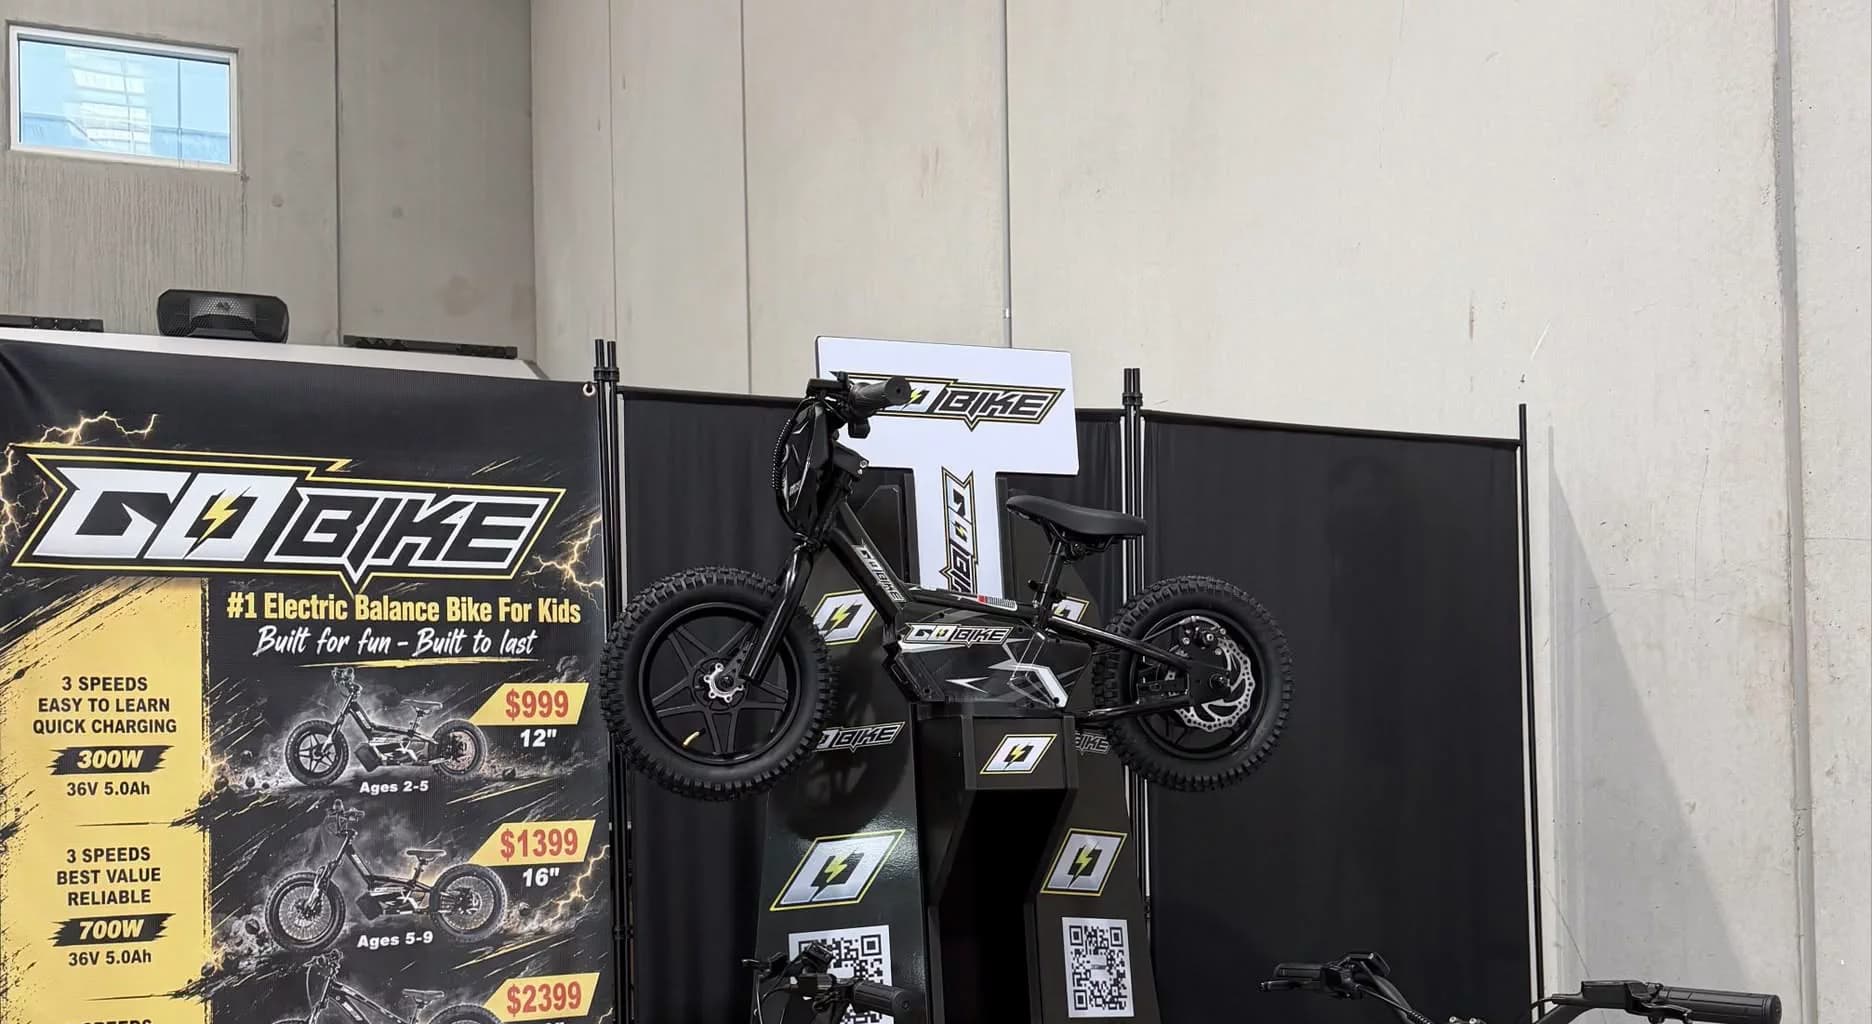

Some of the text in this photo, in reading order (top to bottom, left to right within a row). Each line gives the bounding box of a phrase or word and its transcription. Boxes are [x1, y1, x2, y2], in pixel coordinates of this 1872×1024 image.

[226, 591, 581, 624] #1 Electric Balance Bike For Kids
[252, 625, 311, 657] Built
[316, 629, 350, 655] for
[356, 629, 392, 656] fun
[411, 628, 464, 658] Built
[472, 629, 492, 654] to
[499, 627, 539, 656] last
[62, 676, 148, 692] 3 SPEEDS
[38, 698, 170, 713] EASY TO LEARN
[505, 688, 570, 722] $999
[33, 718, 177, 735] QUICK CHARGING
[520, 728, 558, 748] 12"
[77, 749, 144, 769] 300W
[67, 781, 150, 797] 36V 5.0Ah
[360, 780, 429, 795] Ages 2-5
[66, 846, 151, 863] 3 SPEEDS
[500, 828, 579, 862] $1399
[57, 867, 161, 885] BEST VALUE
[522, 867, 560, 888] 16"
[67, 889, 151, 906] RELIABLE
[79, 919, 144, 940] 700W
[357, 931, 434, 950] Ages 5-9
[68, 949, 151, 966] 36V 5.0Ah
[506, 981, 582, 1017] $2399
